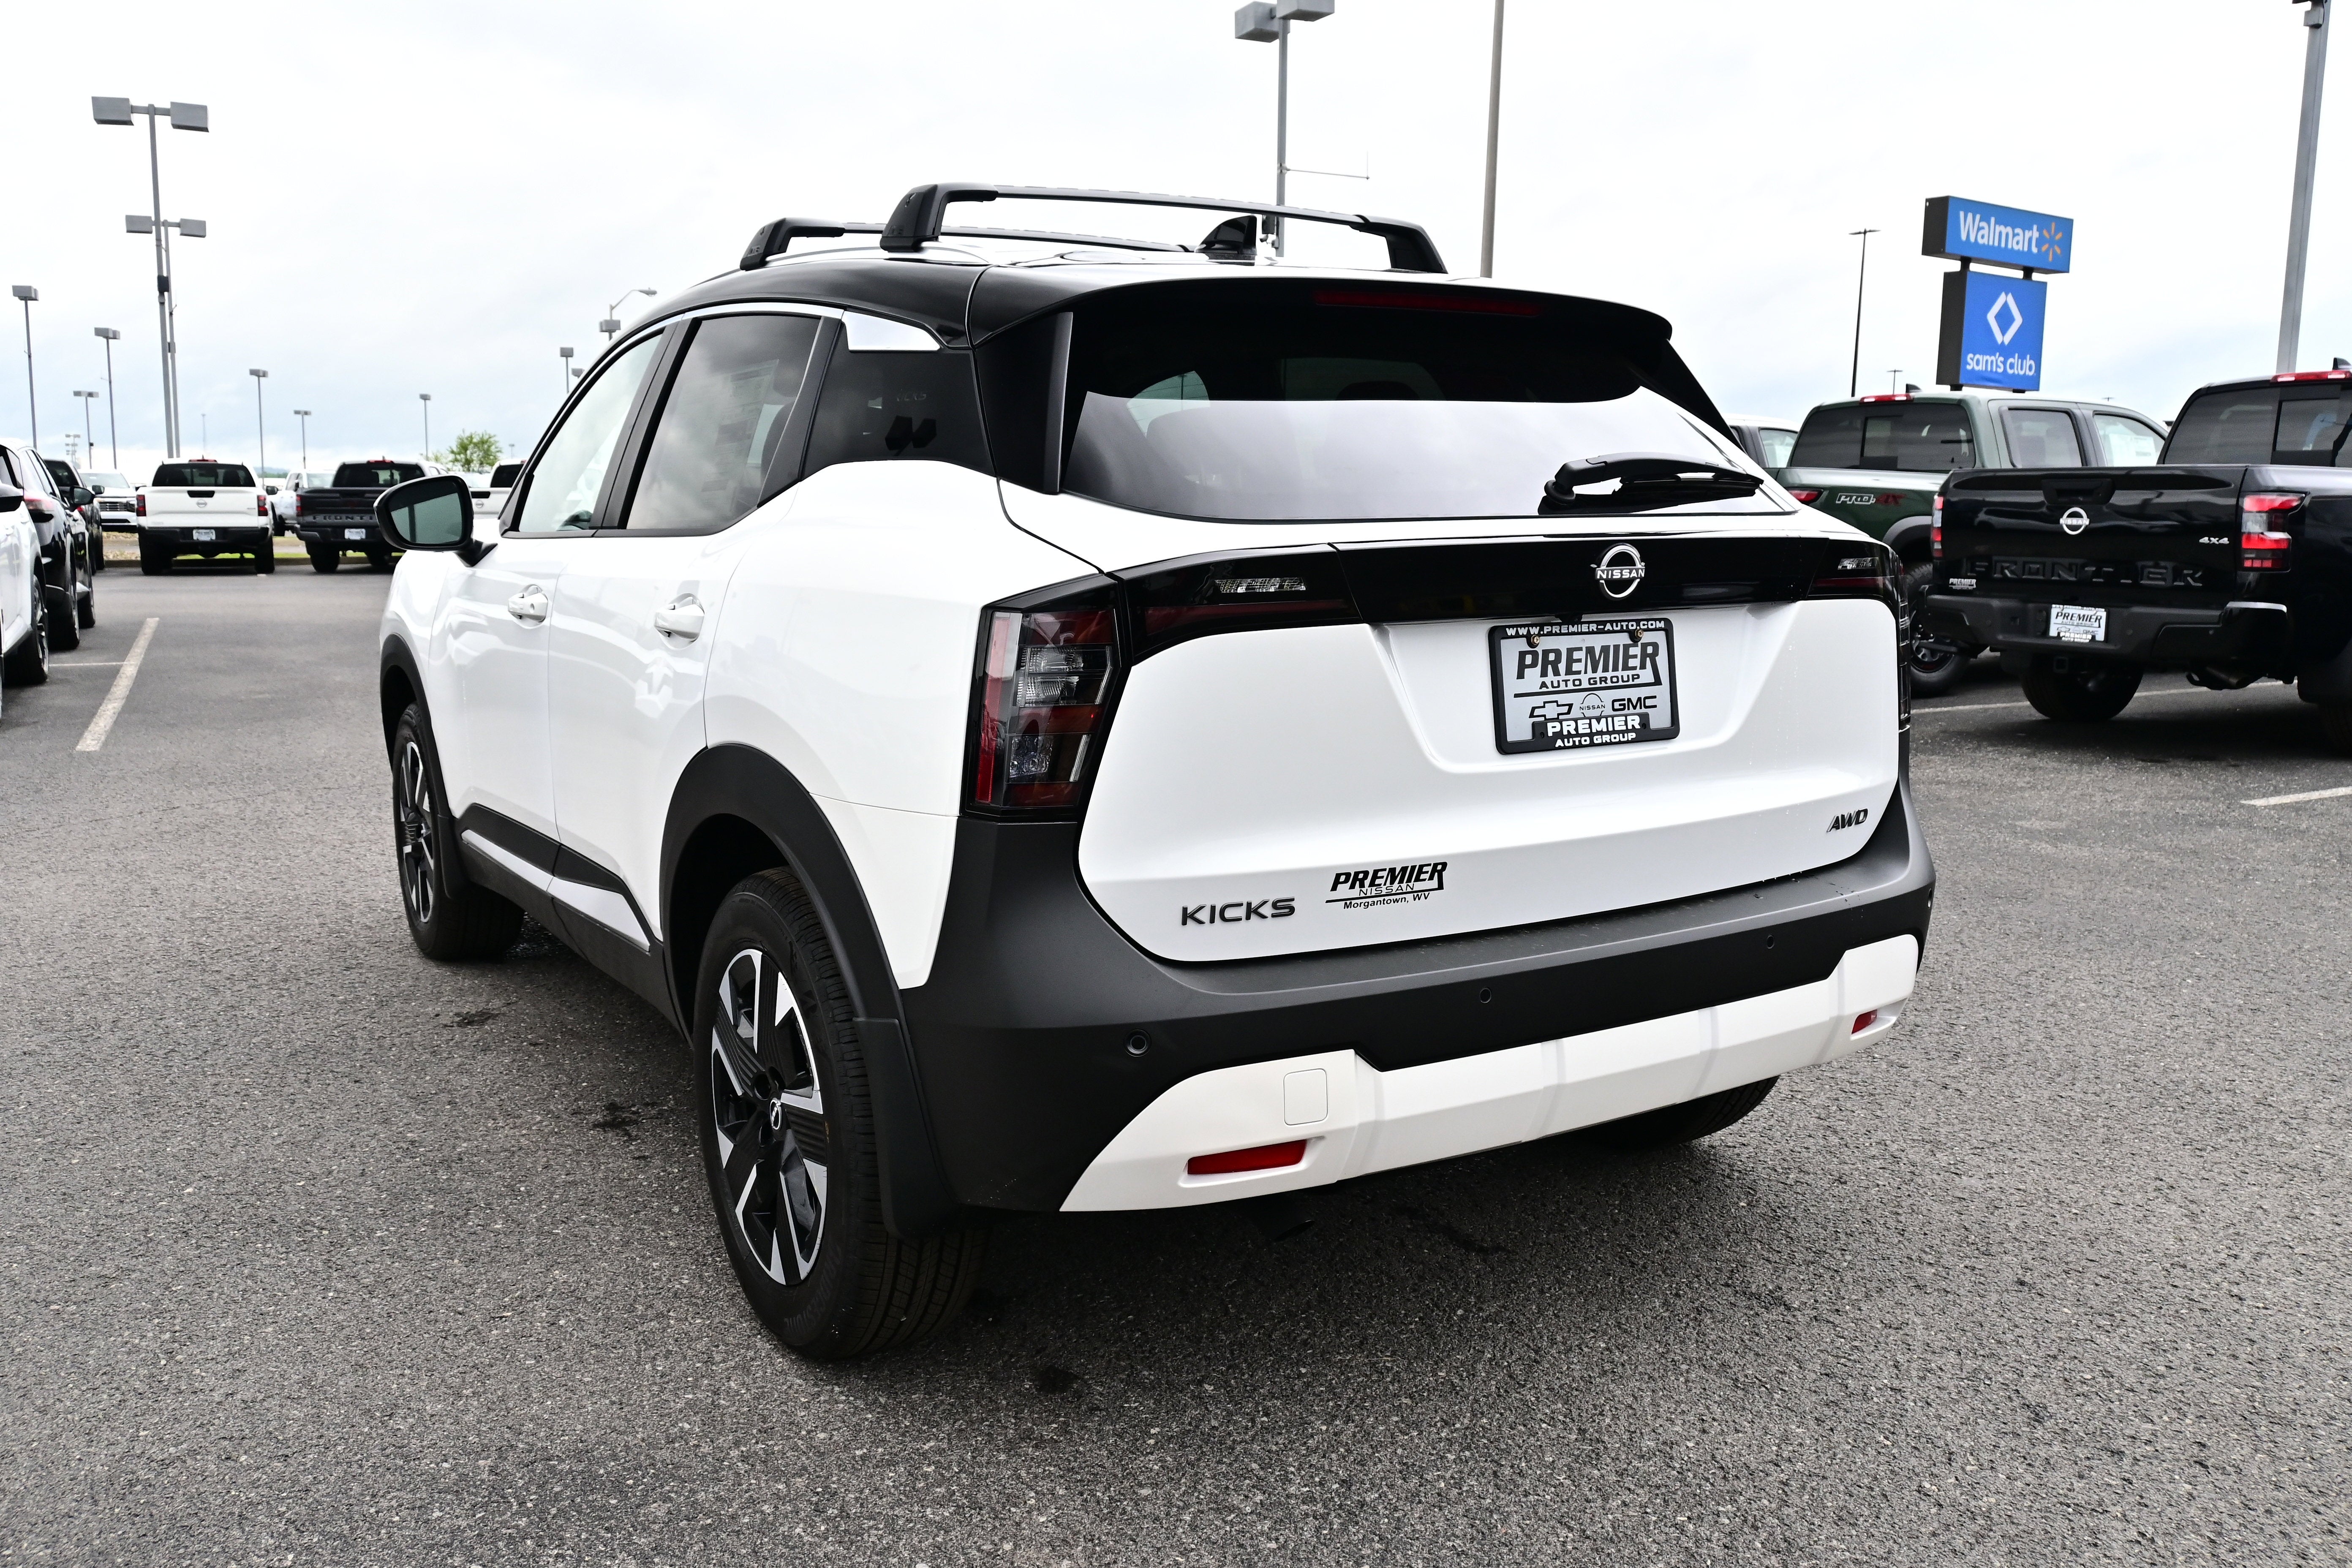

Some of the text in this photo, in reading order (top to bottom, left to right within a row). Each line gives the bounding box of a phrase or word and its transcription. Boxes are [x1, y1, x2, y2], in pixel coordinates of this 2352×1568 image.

[1959, 210, 2039, 253] Walmart
[1966, 352, 2035, 376] sam's club
[1597, 569, 1645, 579] NISSAN
[1967, 561, 2202, 586] FRONTIER
[2055, 611, 2102, 625] PREMIER
[1506, 621, 1665, 636] WWW.PREMIER-AUTO.COM
[2060, 632, 2092, 640] PREMIER
[1516, 641, 1662, 685] PREMIER
[1539, 674, 1641, 689] AUTO GROUP
[1611, 695, 1658, 712] GMC
[1547, 715, 1641, 737] PREMIER
[1555, 732, 1636, 748] AUTO GROUP
[1827, 808, 1868, 833] AWD
[1330, 861, 1448, 892] PREMIER
[1358, 883, 1414, 896] NISSAN
[1343, 892, 1431, 910] Morgantown, WV
[1181, 896, 1296, 926] KICKS
